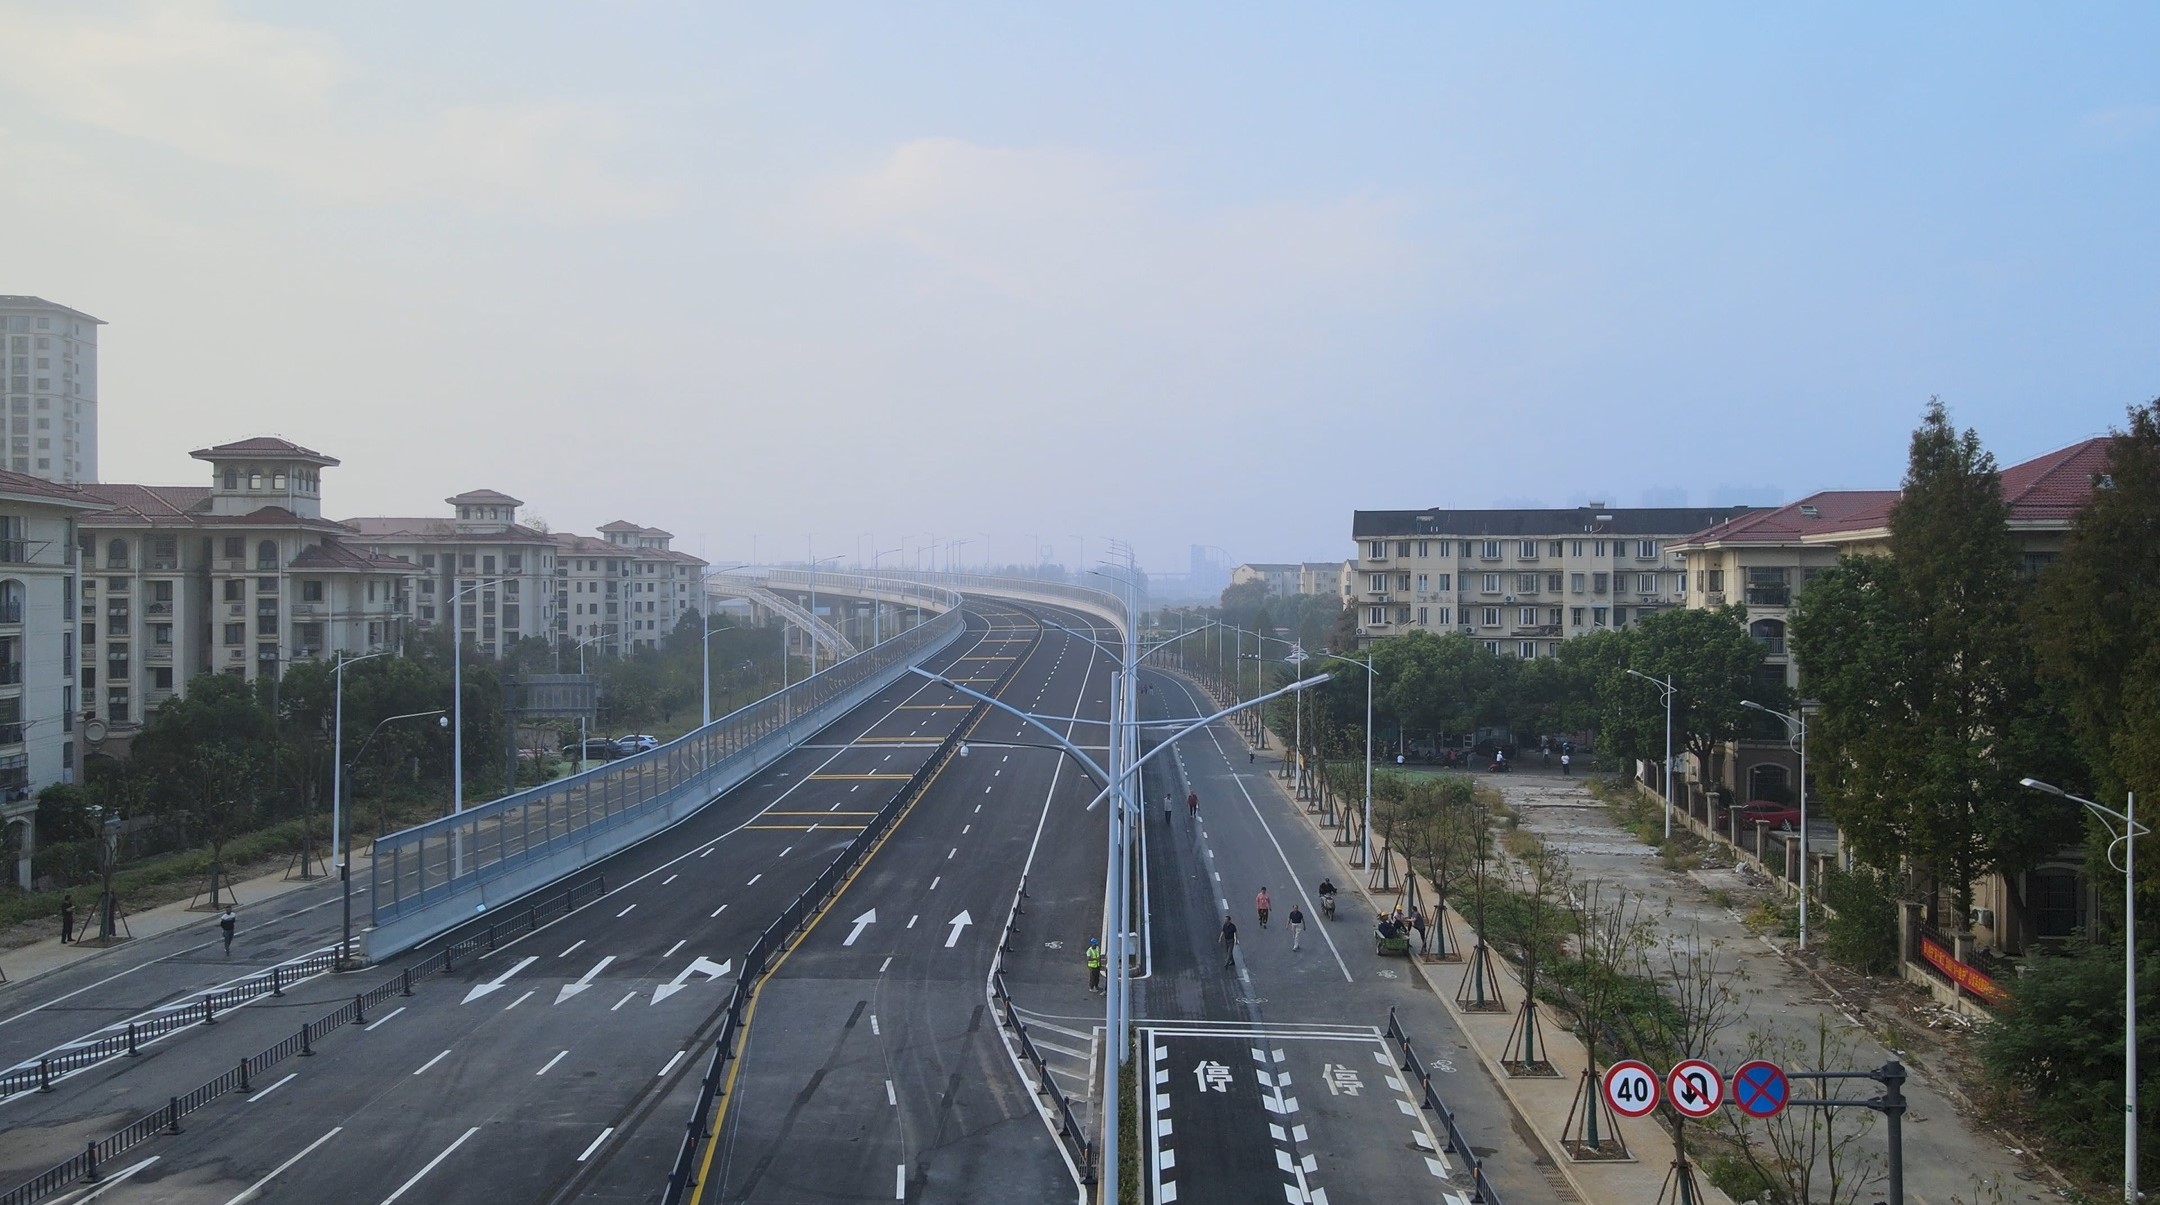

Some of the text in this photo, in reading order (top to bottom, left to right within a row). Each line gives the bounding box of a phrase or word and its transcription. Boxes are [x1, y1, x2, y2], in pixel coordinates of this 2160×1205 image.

[1193, 1060, 1234, 1093] 停
[1322, 1063, 1364, 1097] 停
[1617, 1076, 1648, 1102] 40
